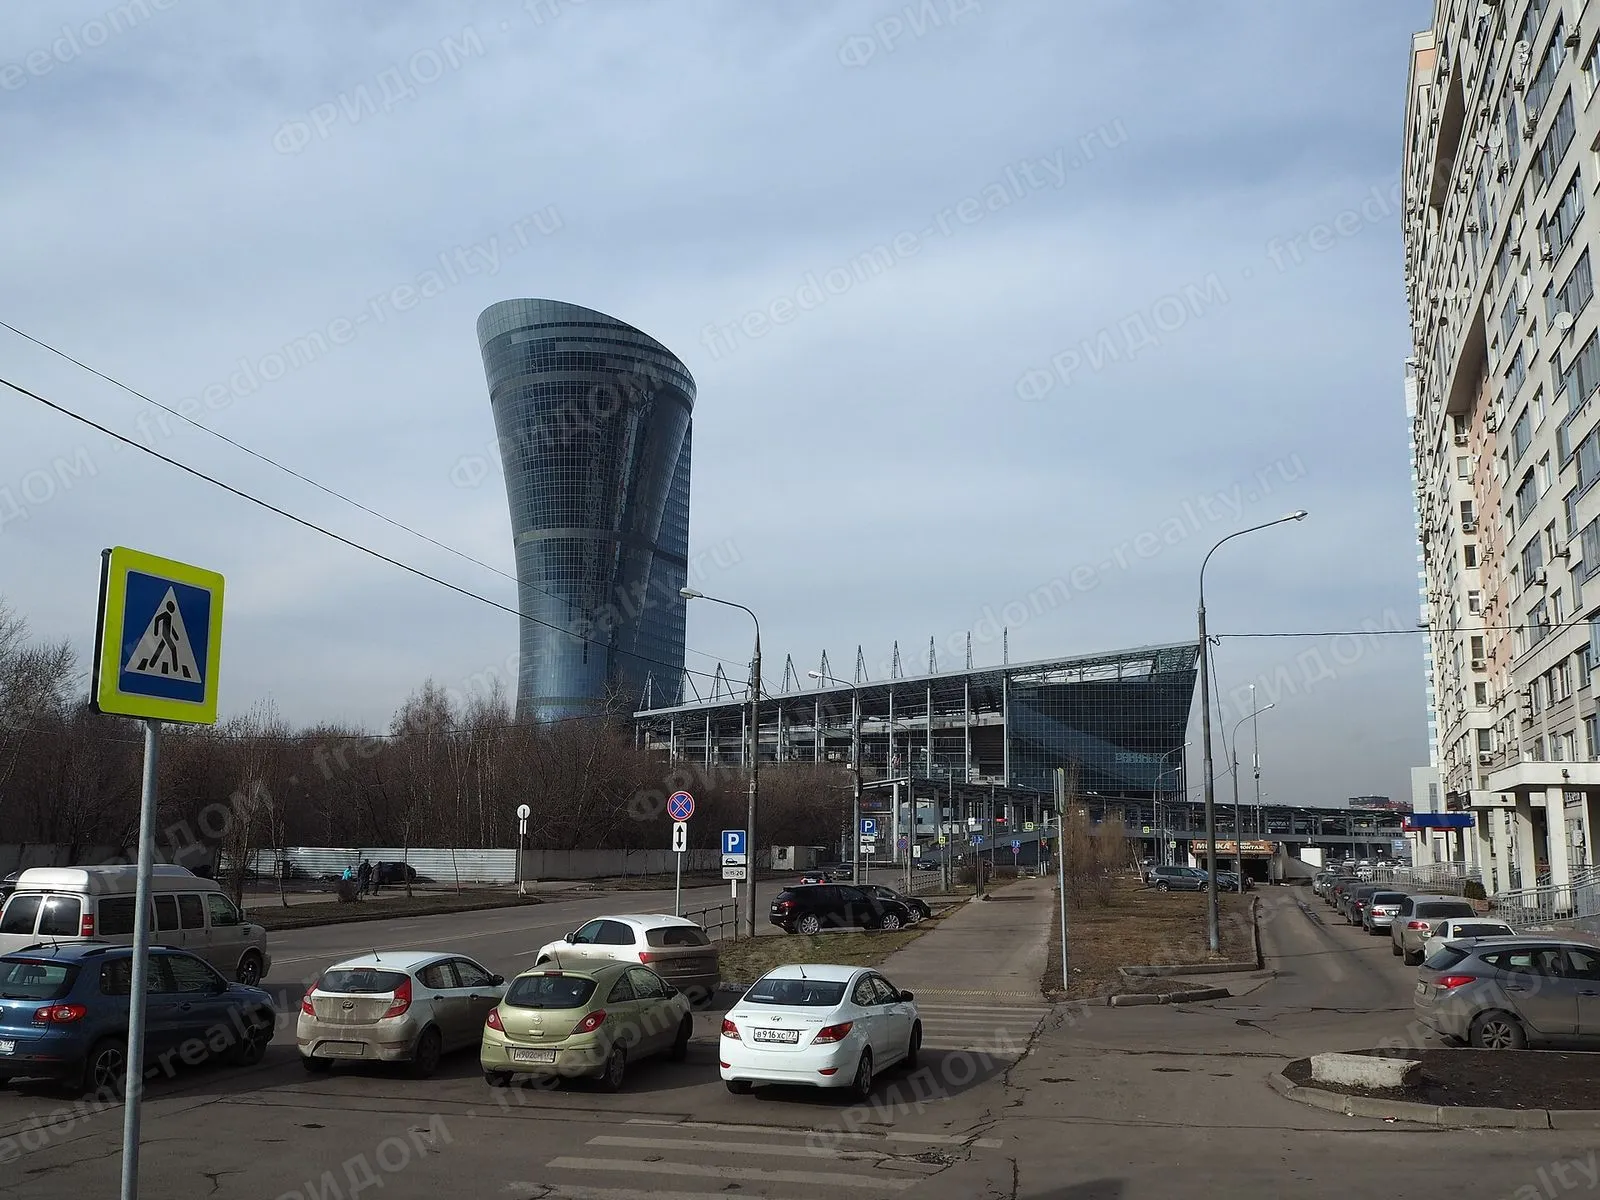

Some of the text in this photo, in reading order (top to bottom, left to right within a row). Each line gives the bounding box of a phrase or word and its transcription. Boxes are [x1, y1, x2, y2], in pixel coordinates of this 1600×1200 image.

[864, 820, 873, 832] P
[728, 833, 740, 852] P
[1196, 842, 1230, 850] МКА
